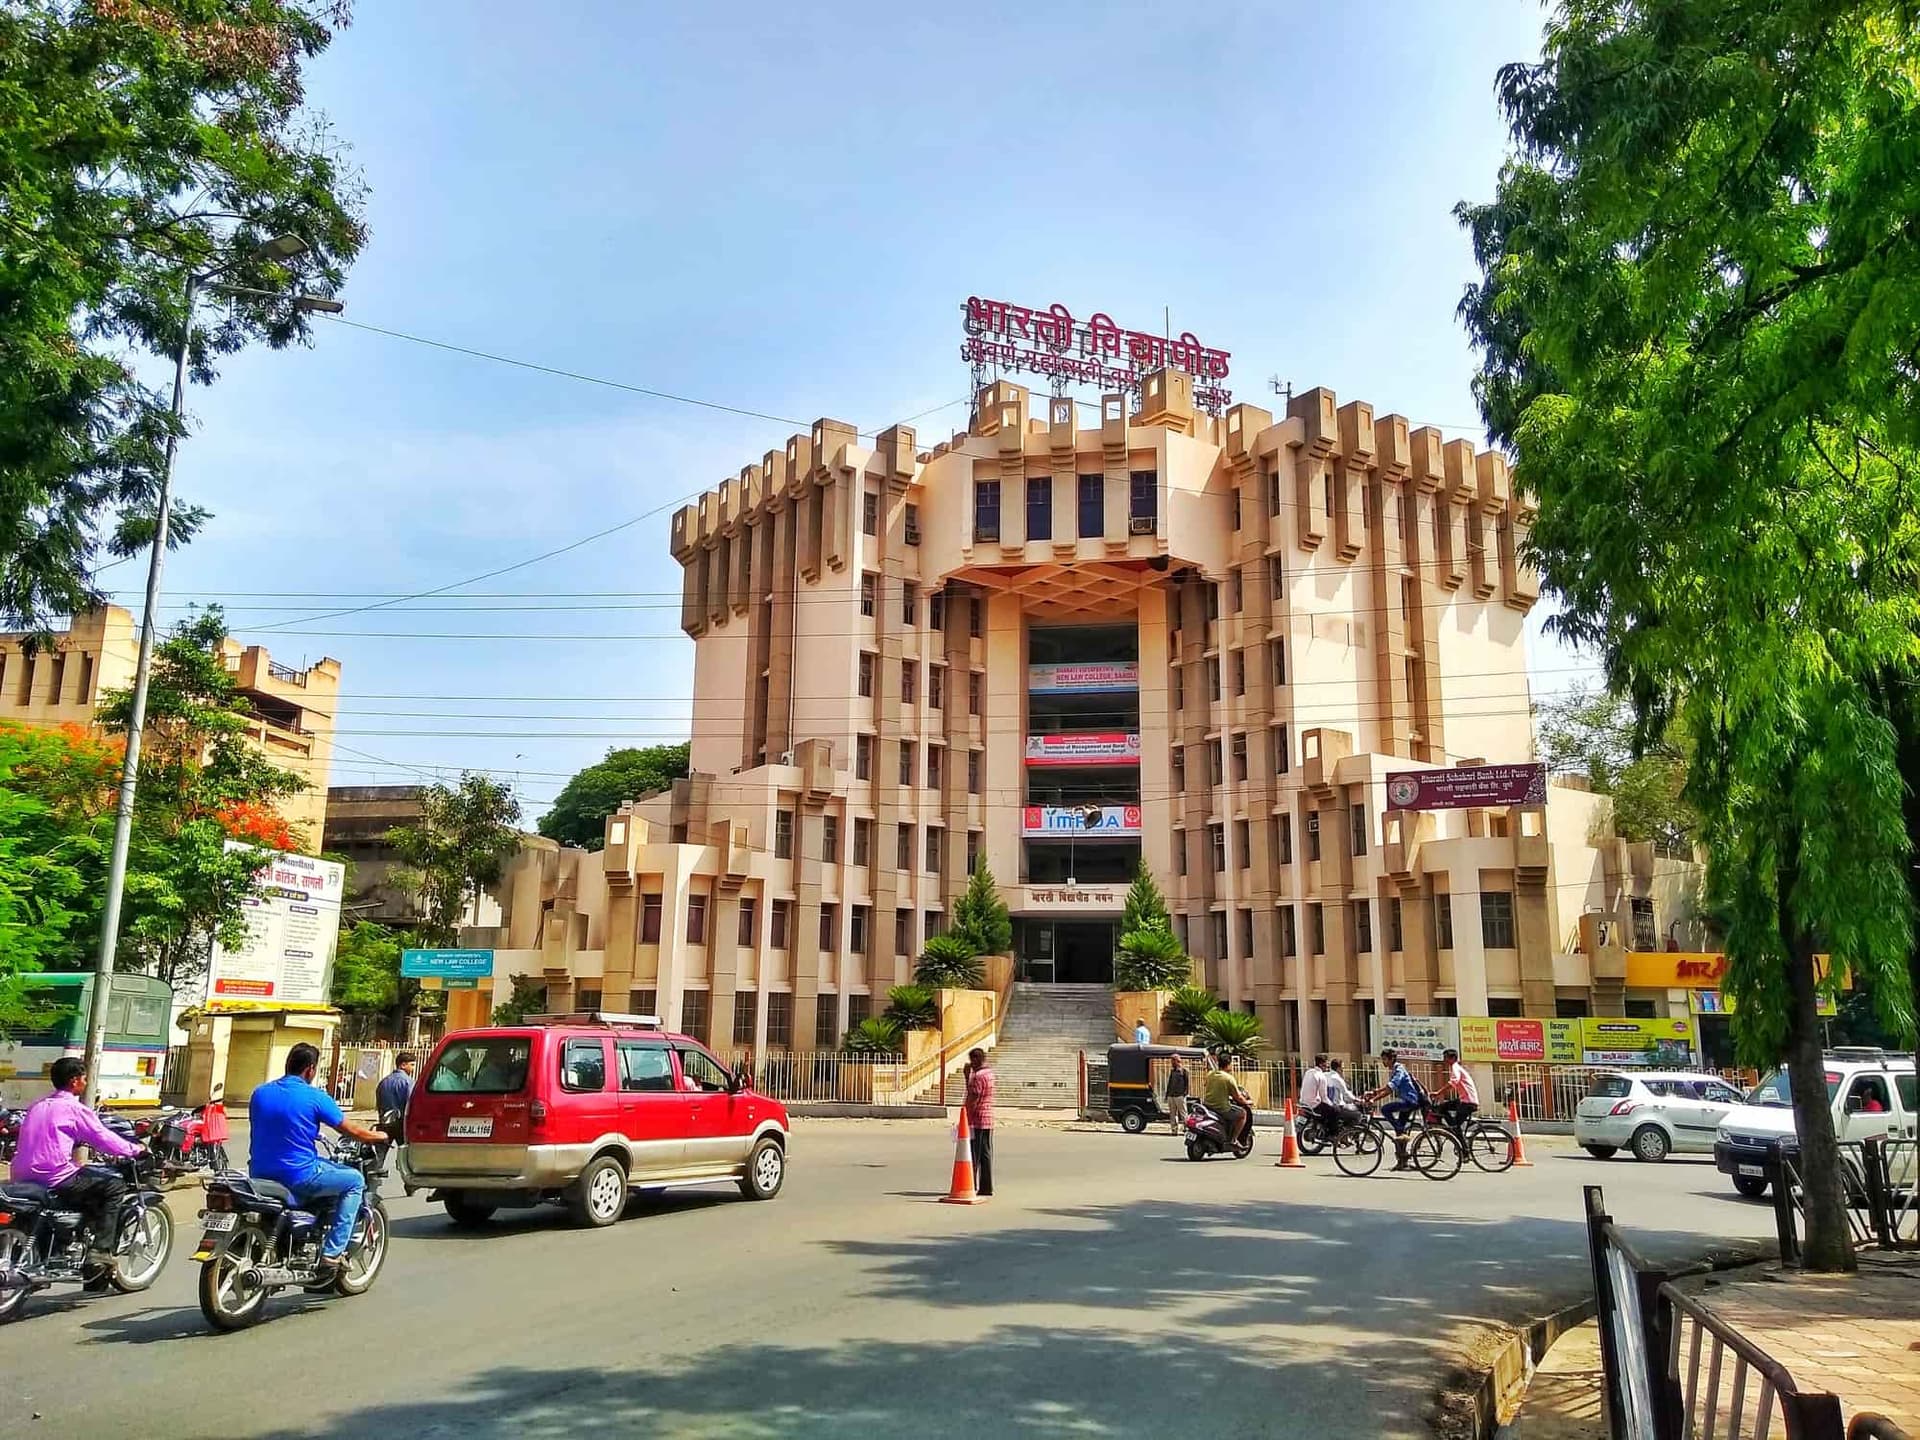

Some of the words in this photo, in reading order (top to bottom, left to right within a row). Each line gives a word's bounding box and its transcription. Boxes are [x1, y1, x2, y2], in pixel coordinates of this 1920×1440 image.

[967, 296, 1073, 350] भारती
[1089, 313, 1231, 378] विद्यापीठ
[1477, 770, 1494, 780] Bank
[1032, 891, 1054, 902] भारती
